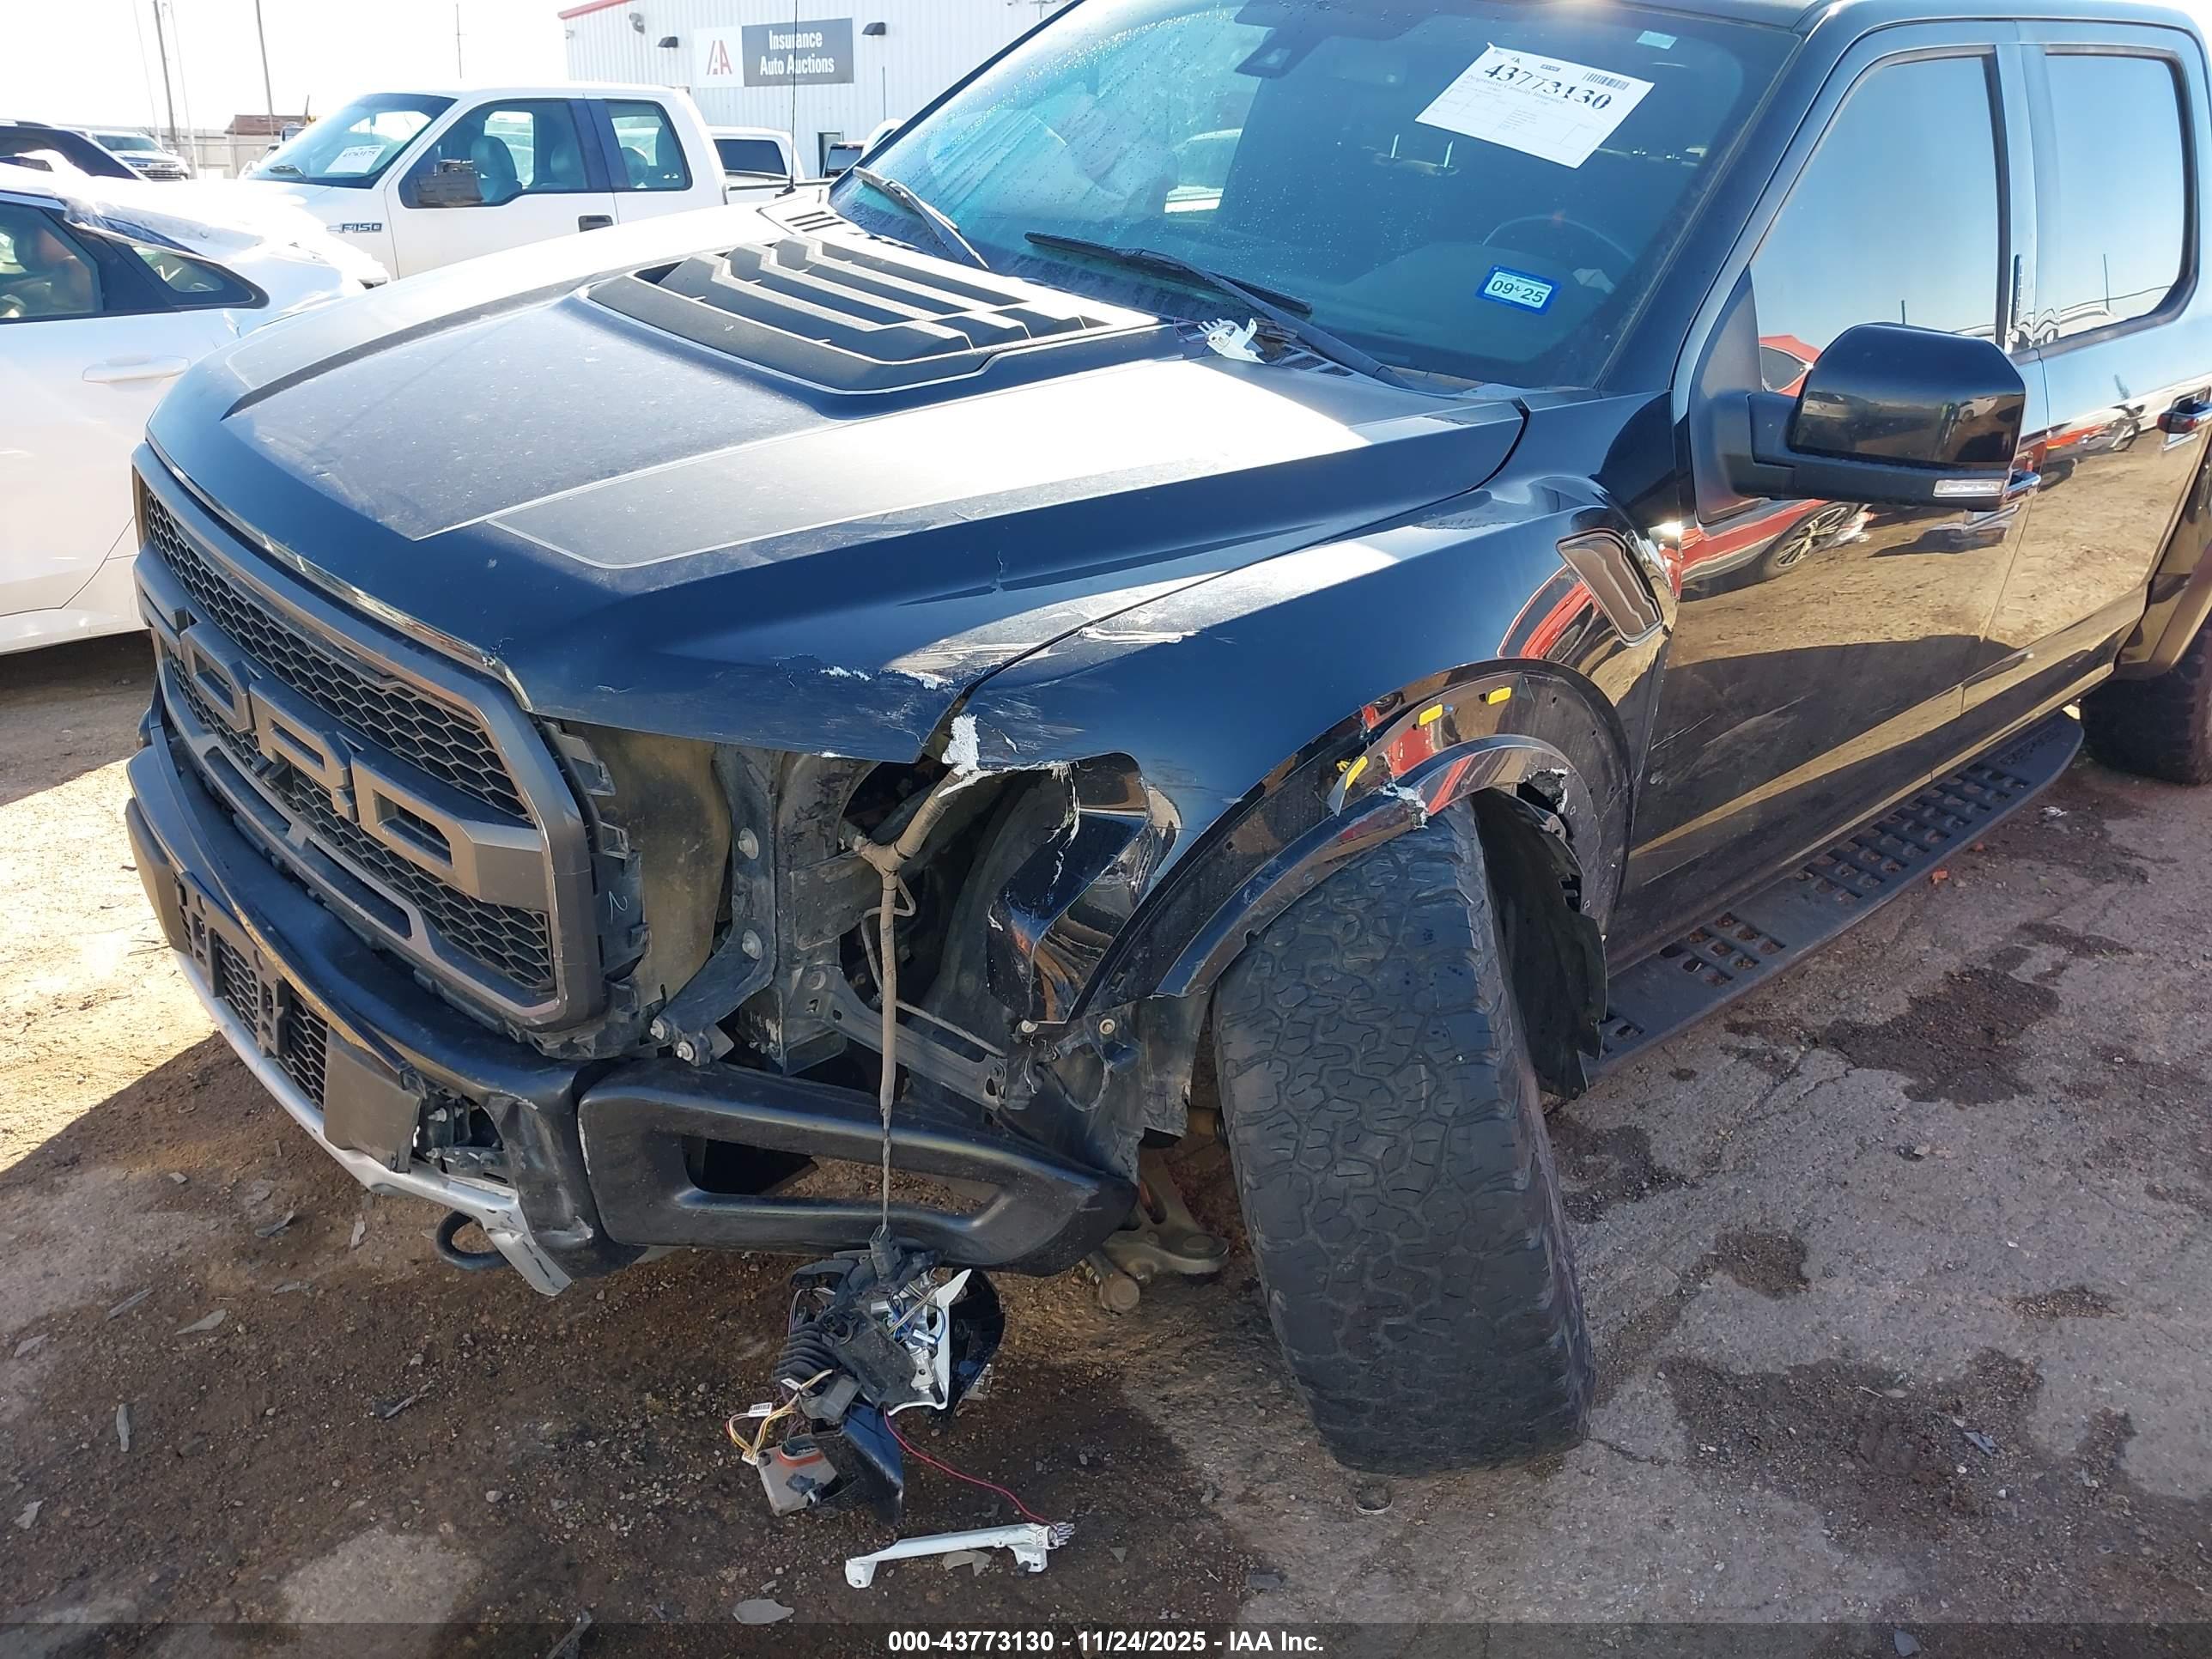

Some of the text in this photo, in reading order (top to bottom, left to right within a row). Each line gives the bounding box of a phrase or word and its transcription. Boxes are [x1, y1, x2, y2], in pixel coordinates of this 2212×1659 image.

[769, 29, 823, 50] Insurance
[759, 52, 835, 76] Auto Auctions
[1484, 63, 1613, 110] 43773130
[1491, 280, 1515, 294] 09
[1520, 288, 1546, 302] 25
